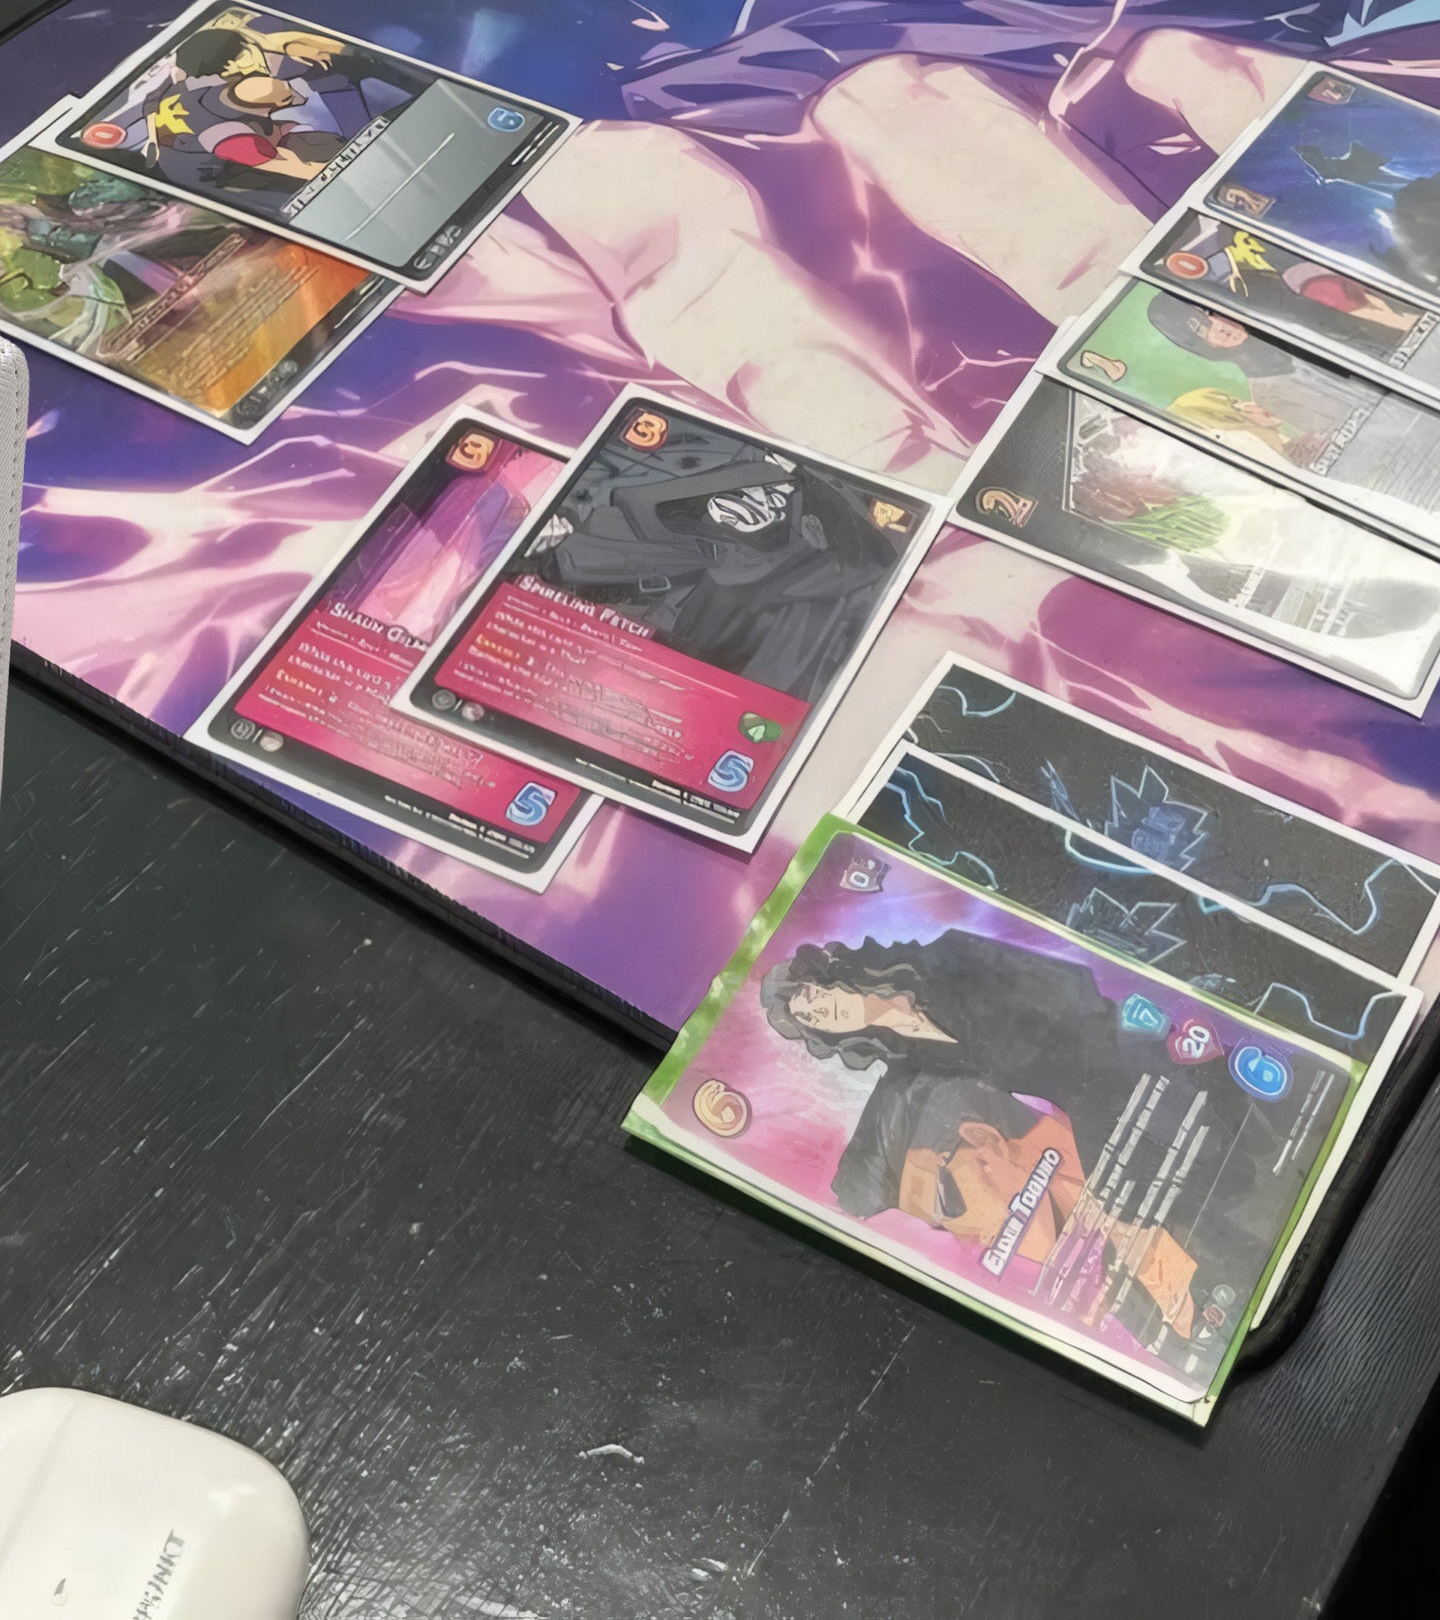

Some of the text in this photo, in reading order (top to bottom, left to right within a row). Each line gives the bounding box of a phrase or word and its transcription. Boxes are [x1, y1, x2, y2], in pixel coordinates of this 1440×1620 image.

[707, 748, 755, 794] 5
[505, 781, 558, 827] 5
[1181, 1024, 1212, 1060] 20
